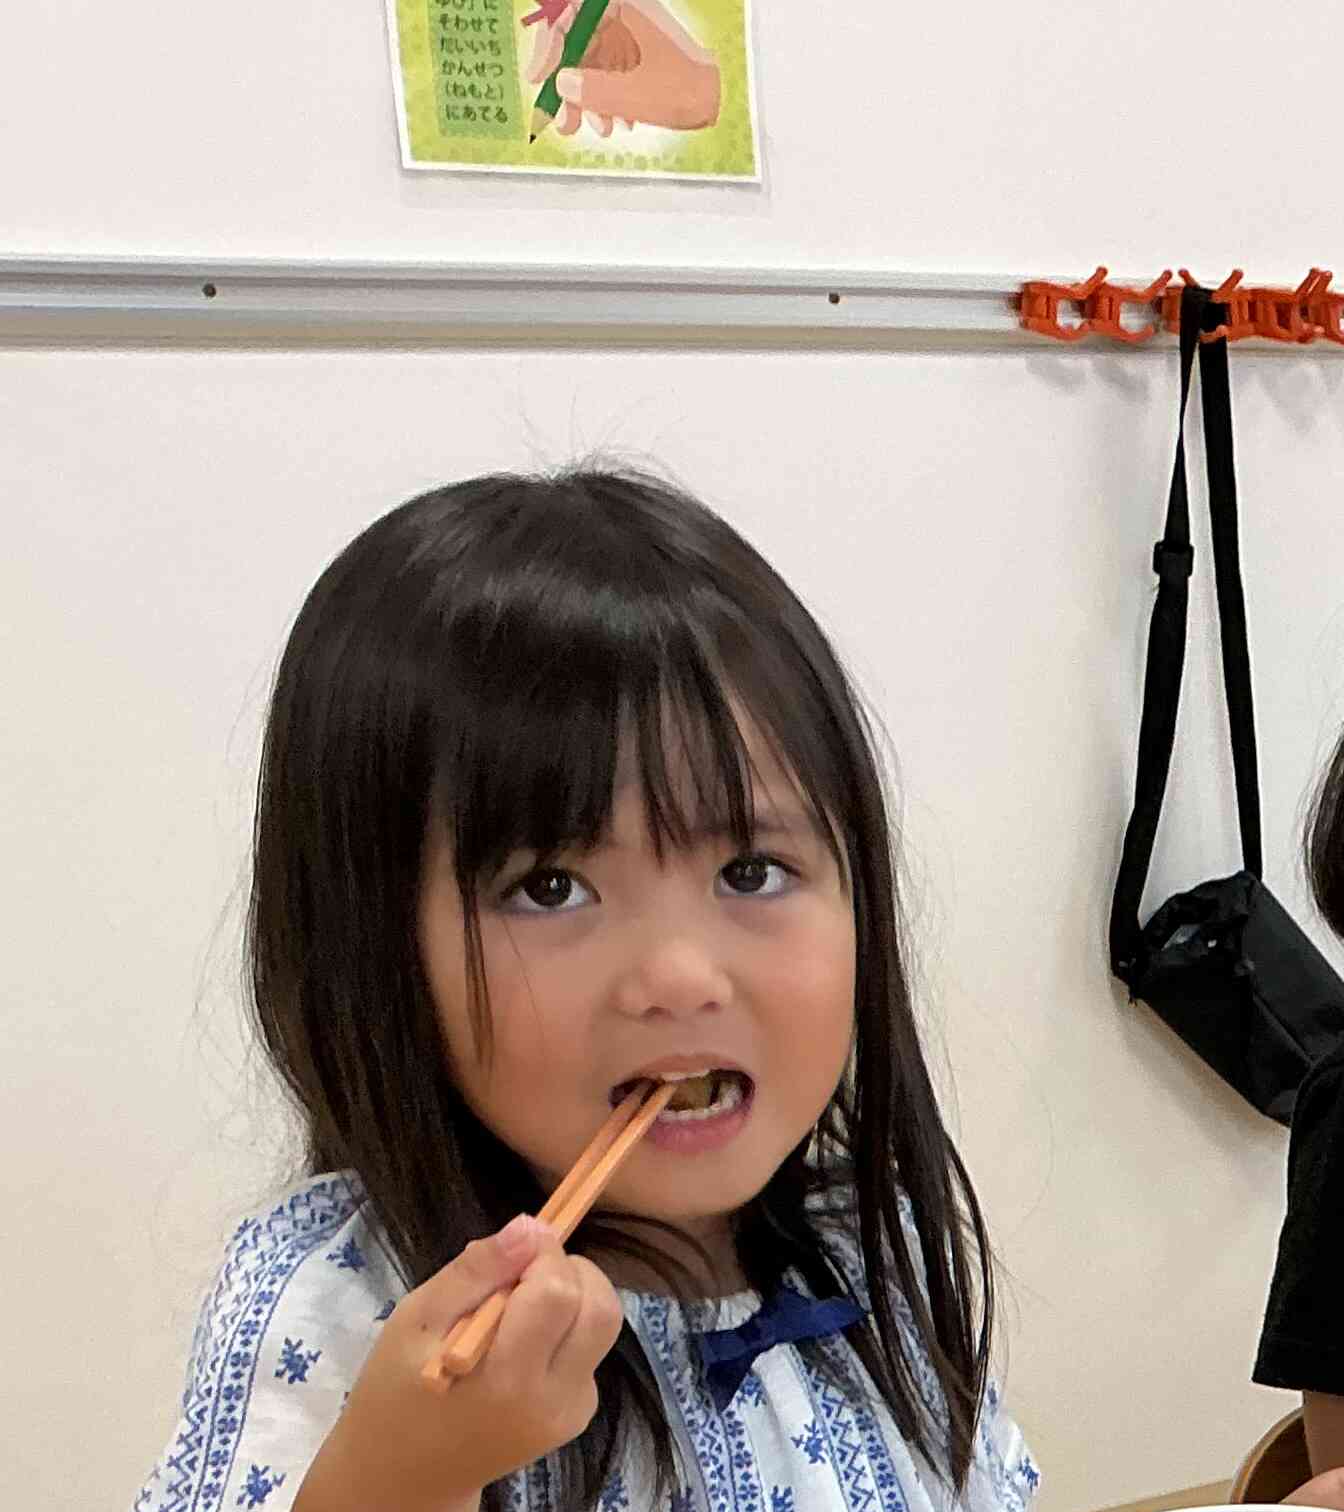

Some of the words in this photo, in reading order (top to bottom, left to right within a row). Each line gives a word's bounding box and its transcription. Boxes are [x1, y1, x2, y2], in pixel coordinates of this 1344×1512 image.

[439, 13, 498, 34] そわせて
[441, 60, 504, 77] かんせつ
[445, 104, 508, 123] にあてる
